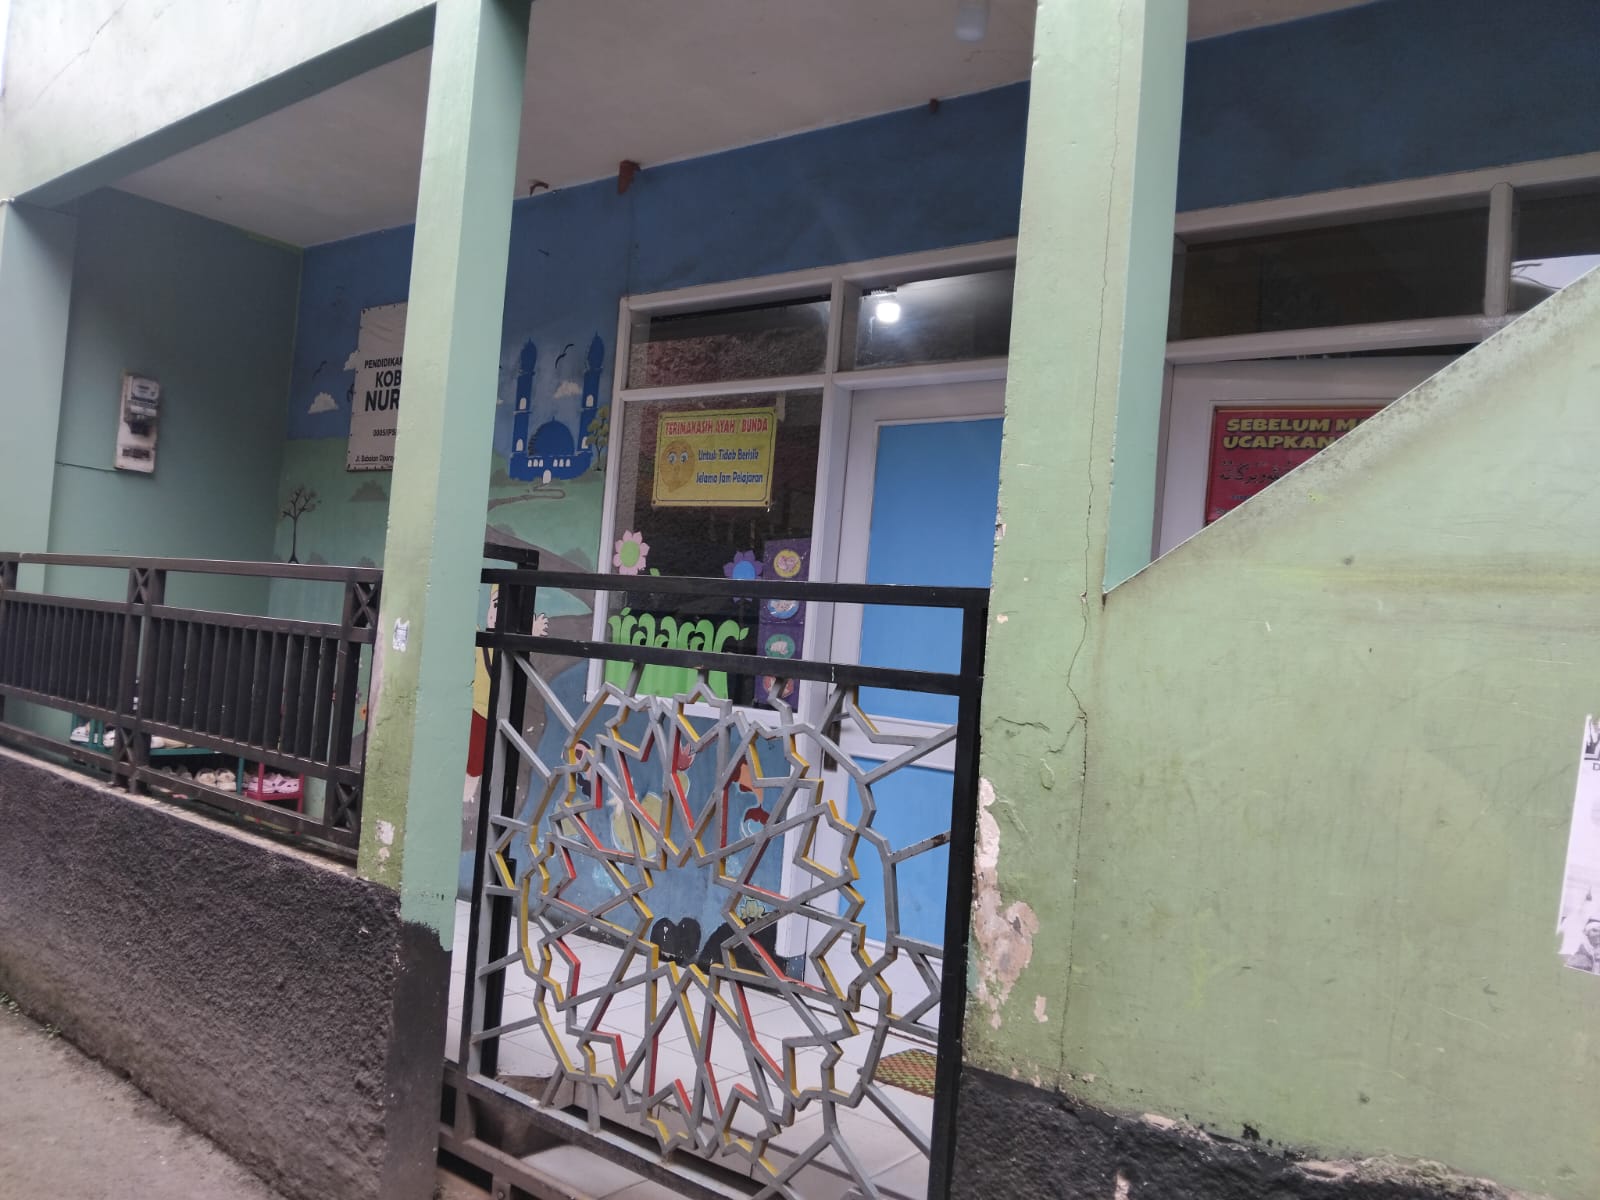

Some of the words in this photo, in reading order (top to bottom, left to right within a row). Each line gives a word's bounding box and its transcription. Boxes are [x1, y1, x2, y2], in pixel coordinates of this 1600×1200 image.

[375, 370, 402, 388] KOB
[365, 388, 400, 411] NUR
[741, 417, 768, 433] BUNDA
[1227, 418, 1331, 432] SEBELUM
[1223, 435, 1337, 449] UCAPKAN
